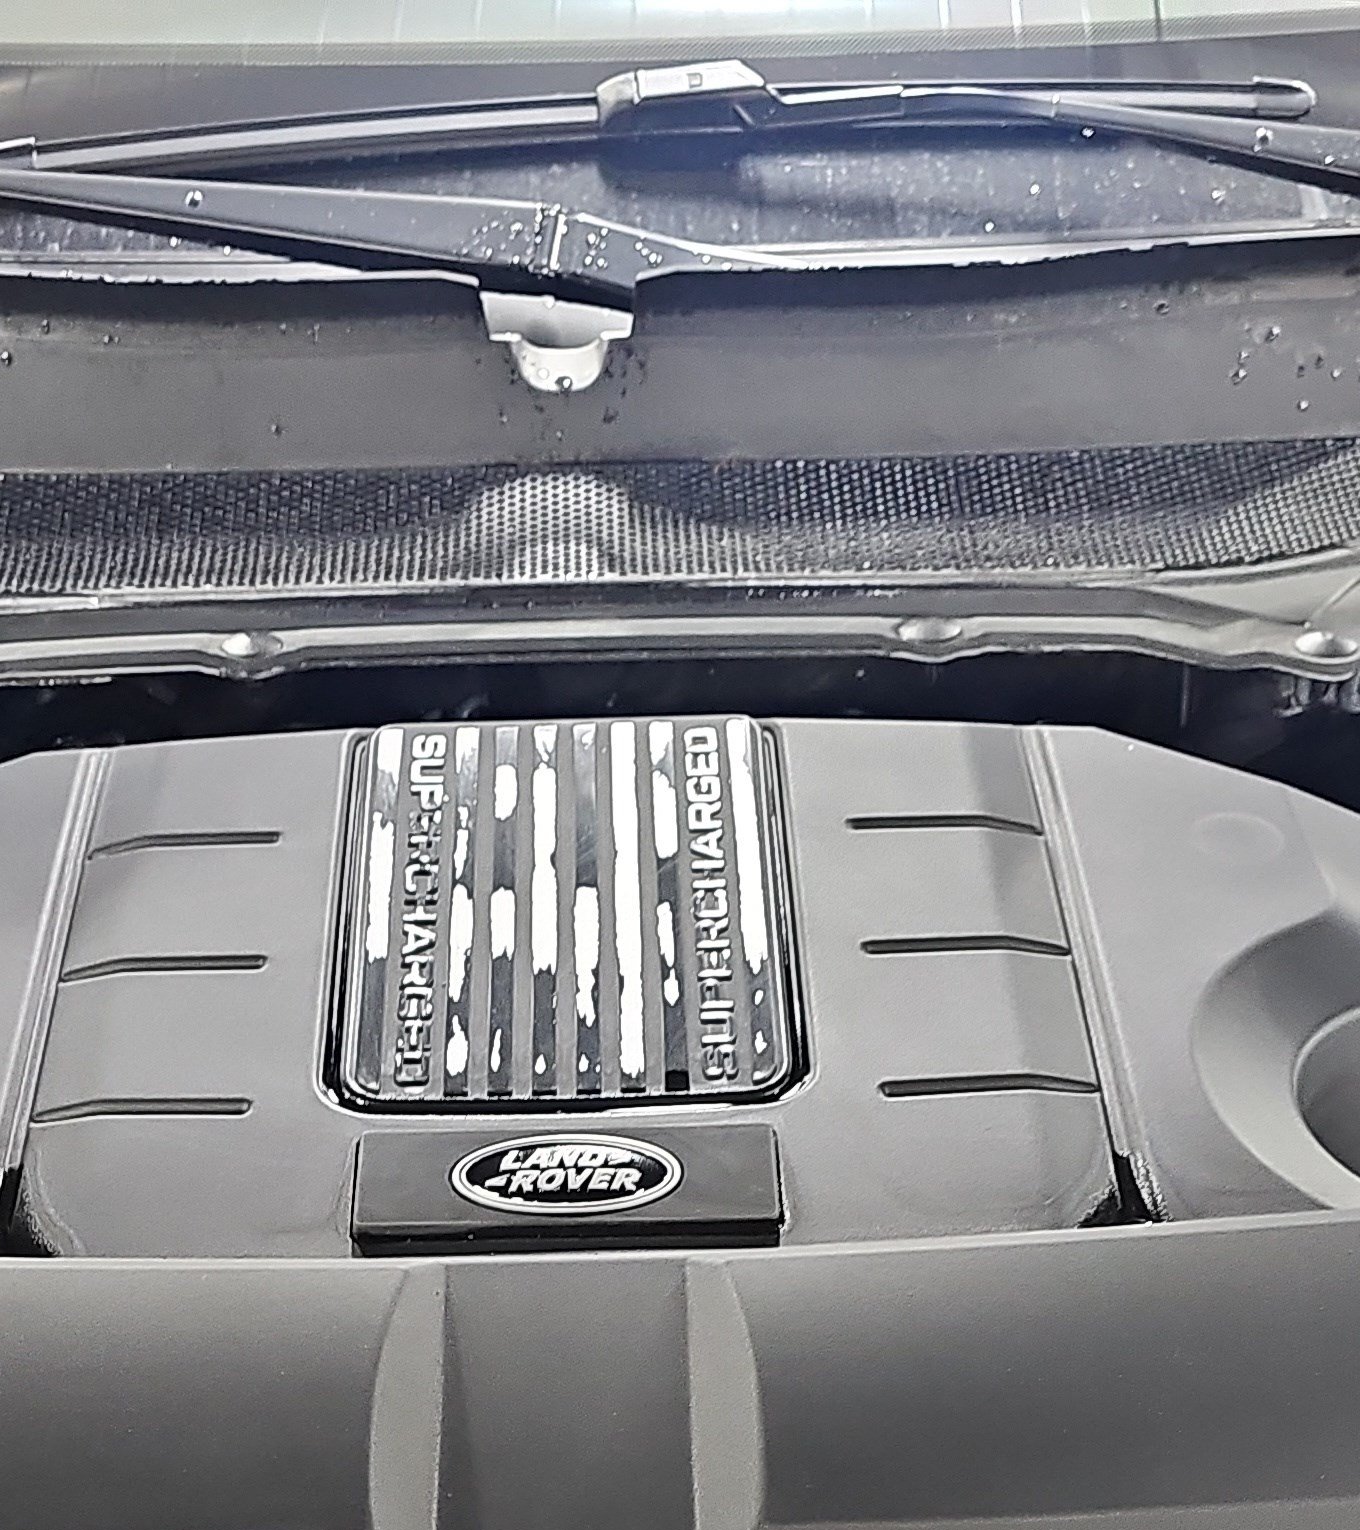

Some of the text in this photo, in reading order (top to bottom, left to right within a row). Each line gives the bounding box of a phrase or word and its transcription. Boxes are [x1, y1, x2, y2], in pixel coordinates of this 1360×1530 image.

[394, 733, 448, 1088] SUPERCHARGED
[683, 726, 740, 1081] SUPERCHARGED
[499, 1145, 607, 1172] LAND
[507, 1167, 642, 1194] ROVER
